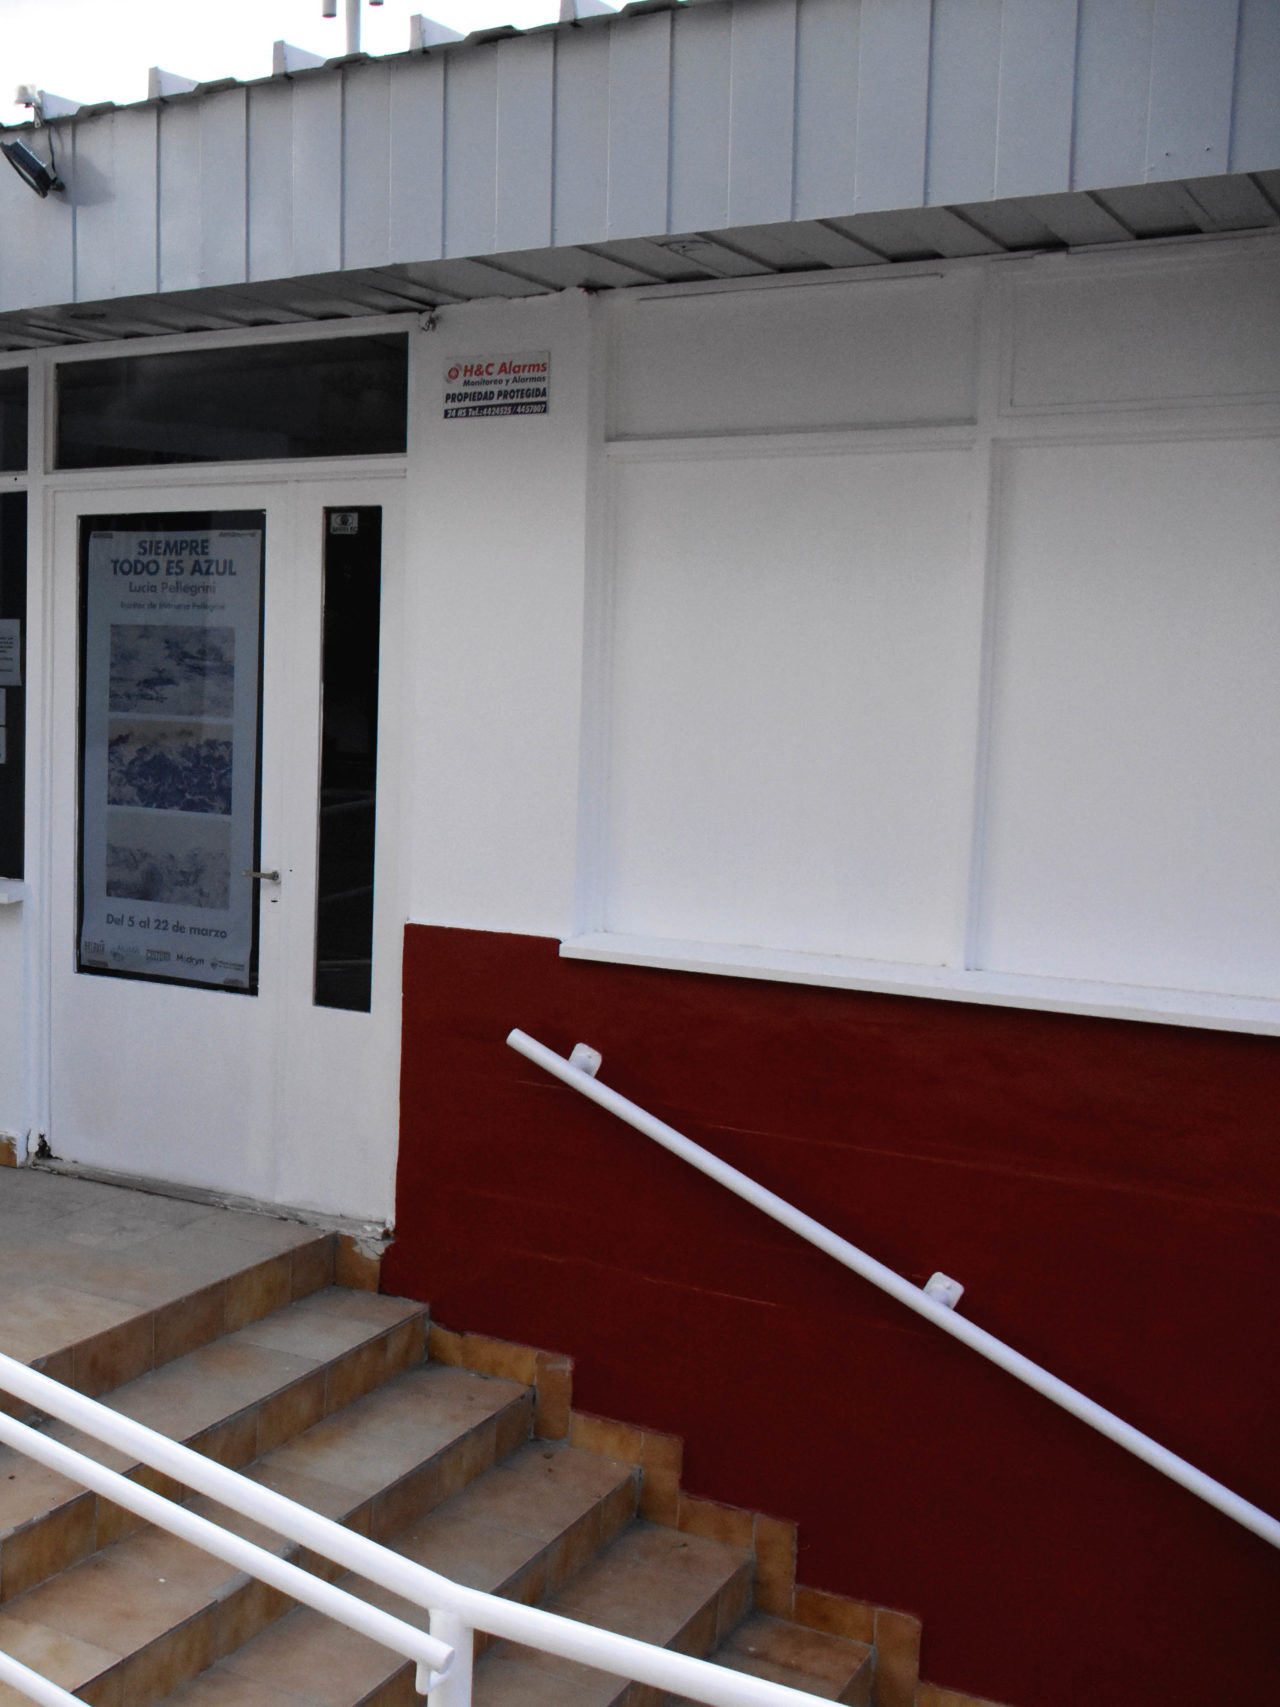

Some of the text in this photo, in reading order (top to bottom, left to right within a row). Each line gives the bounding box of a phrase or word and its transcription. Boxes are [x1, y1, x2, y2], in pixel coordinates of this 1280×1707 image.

[463, 361, 547, 377] H&C Alarms
[463, 378, 503, 387] Monitoreo
[512, 376, 546, 384] Alarmas
[445, 387, 547, 403] PROPIEDAD PROTEGIDA
[137, 539, 209, 556] SIEMPRE
[111, 559, 237, 576] TODO ES AZUL
[161, 580, 216, 597] Pellegrini
[106, 913, 228, 939] Del 5 al 22 de marzo
[176, 953, 205, 966] Mdryn
